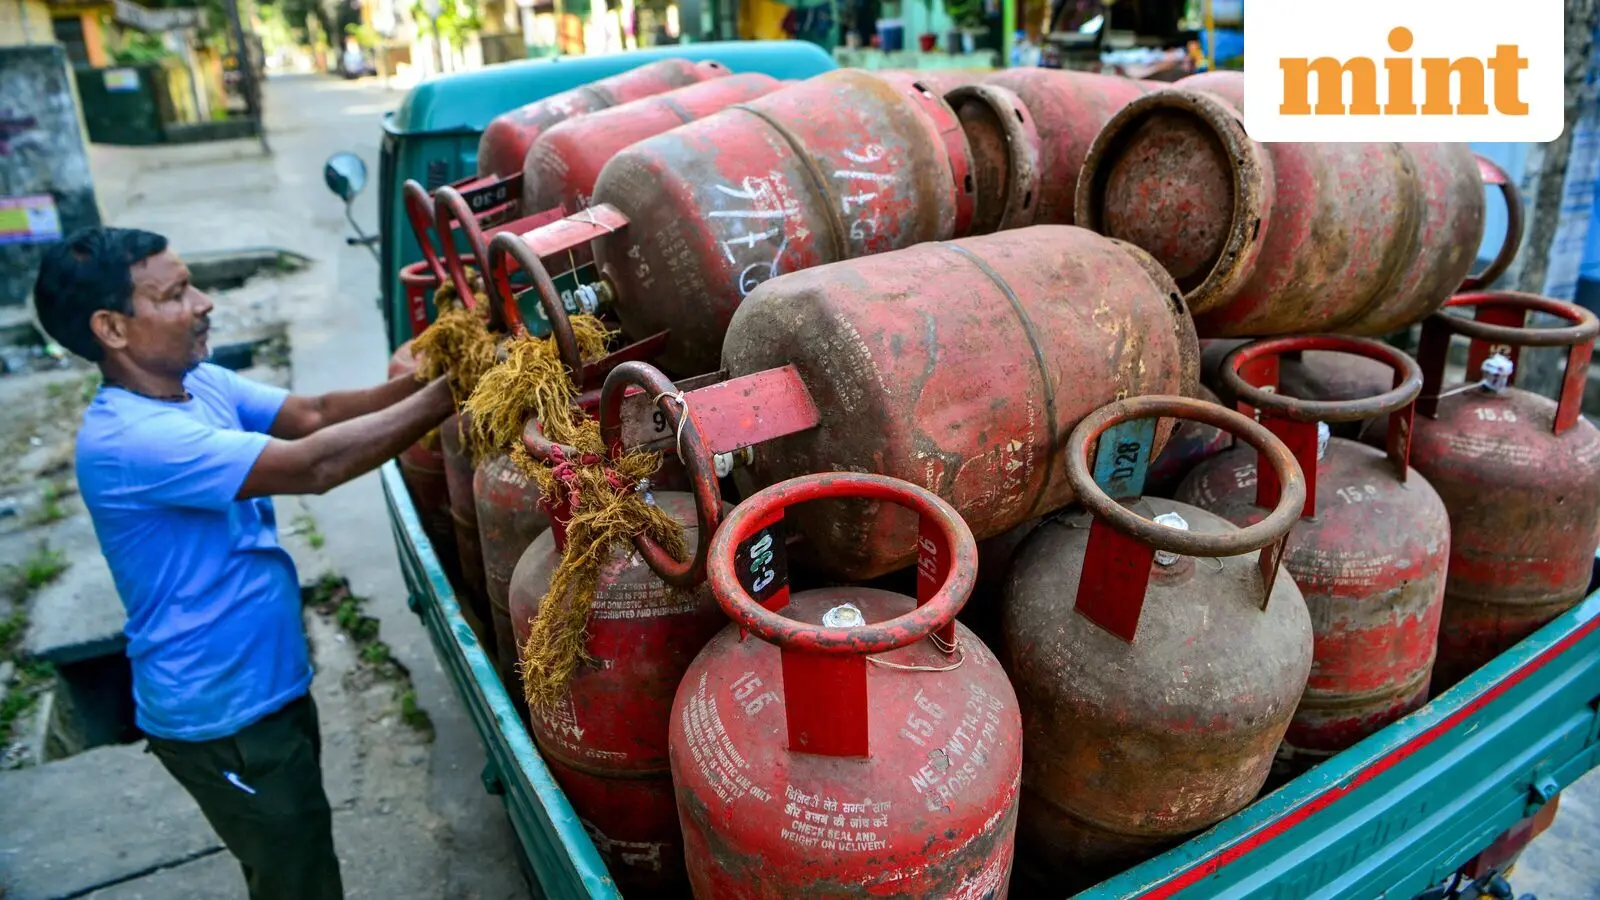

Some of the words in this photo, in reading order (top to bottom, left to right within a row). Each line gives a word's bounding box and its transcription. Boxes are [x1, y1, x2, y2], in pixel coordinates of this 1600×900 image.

[1473, 407, 1517, 423] 15.6
[750, 533, 775, 593] C-30
[917, 535, 938, 585] 15.6
[729, 671, 781, 716] 15.6
[708, 696, 726, 737] STATUTORY
[721, 734, 745, 768] WARNING
[898, 688, 946, 747] 15.6
[691, 746, 702, 763] AND
[749, 786, 772, 803] ONLY
[780, 827, 820, 847] WEIGHT
[821, 840, 836, 851] ON
[791, 820, 825, 838] CHECK
[827, 828, 853, 842] SEAL
[855, 832, 877, 843] AND
